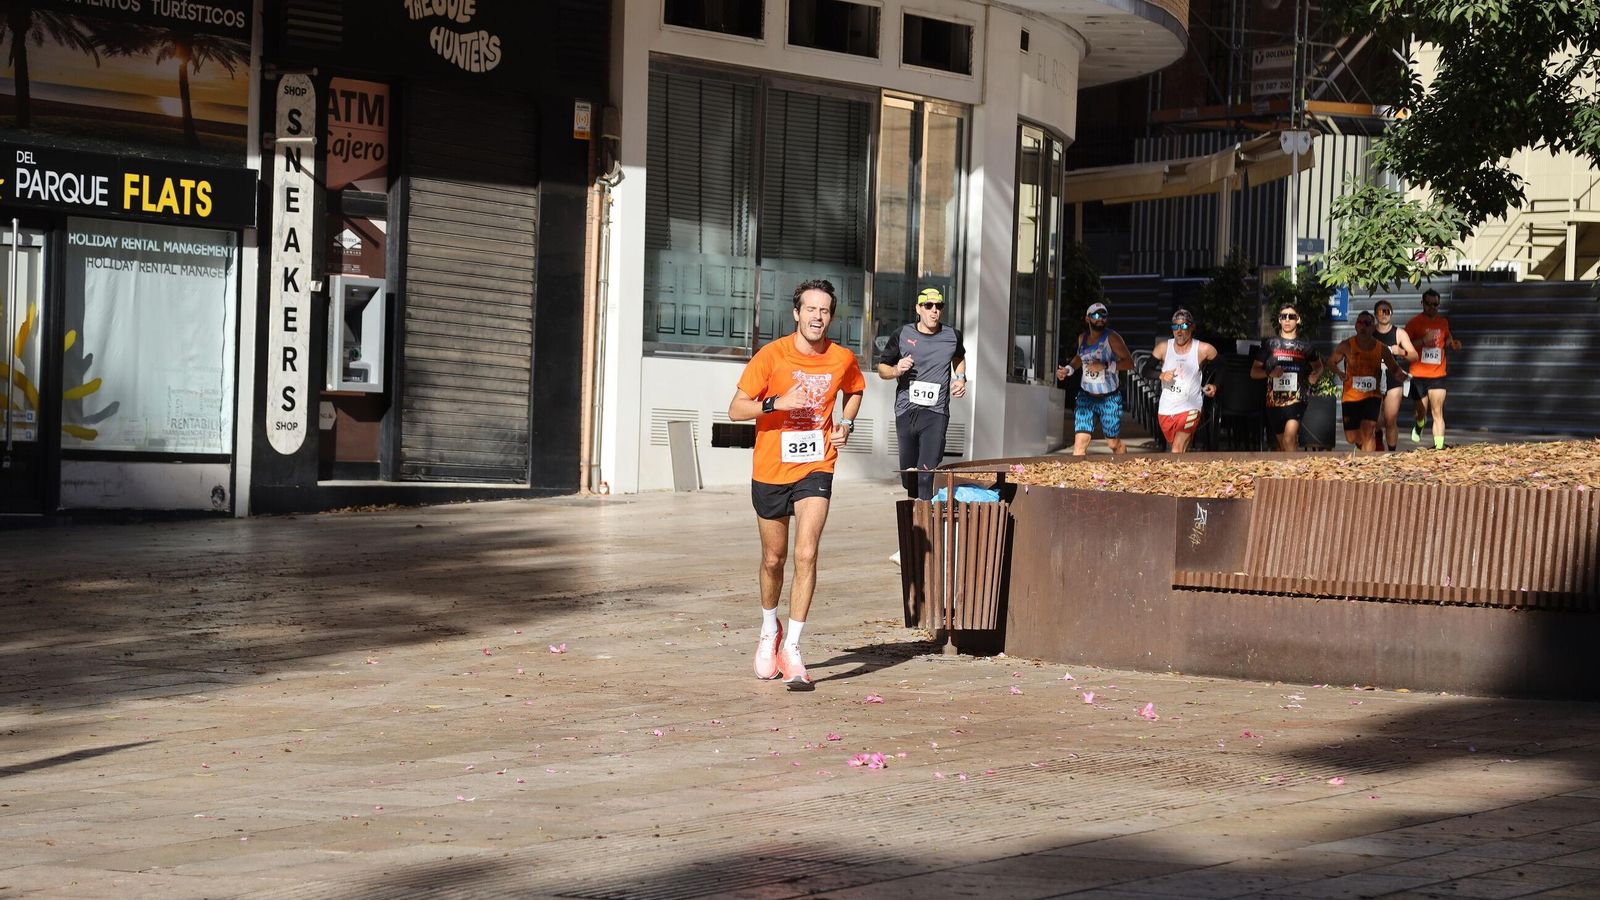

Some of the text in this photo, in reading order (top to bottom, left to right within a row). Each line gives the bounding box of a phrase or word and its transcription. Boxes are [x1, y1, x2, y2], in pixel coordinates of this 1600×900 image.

[152, 0, 245, 28] TURÍSTICOS
[429, 26, 502, 73] HUNTERS
[284, 85, 307, 97] SHOP
[328, 88, 385, 127] ATM
[16, 150, 37, 165] DEL
[15, 167, 213, 218] PARQUE FLATS
[68, 232, 234, 257] HOLIDAY RENTAL MANAGEMENT
[86, 257, 135, 271] HOLIDAY
[139, 261, 177, 275] RENTAL
[281, 108, 303, 412] SNEAKERS
[913, 389, 935, 399] 510
[1355, 381, 1373, 389] 730
[275, 421, 299, 431] SHOP
[788, 441, 817, 454] 321
